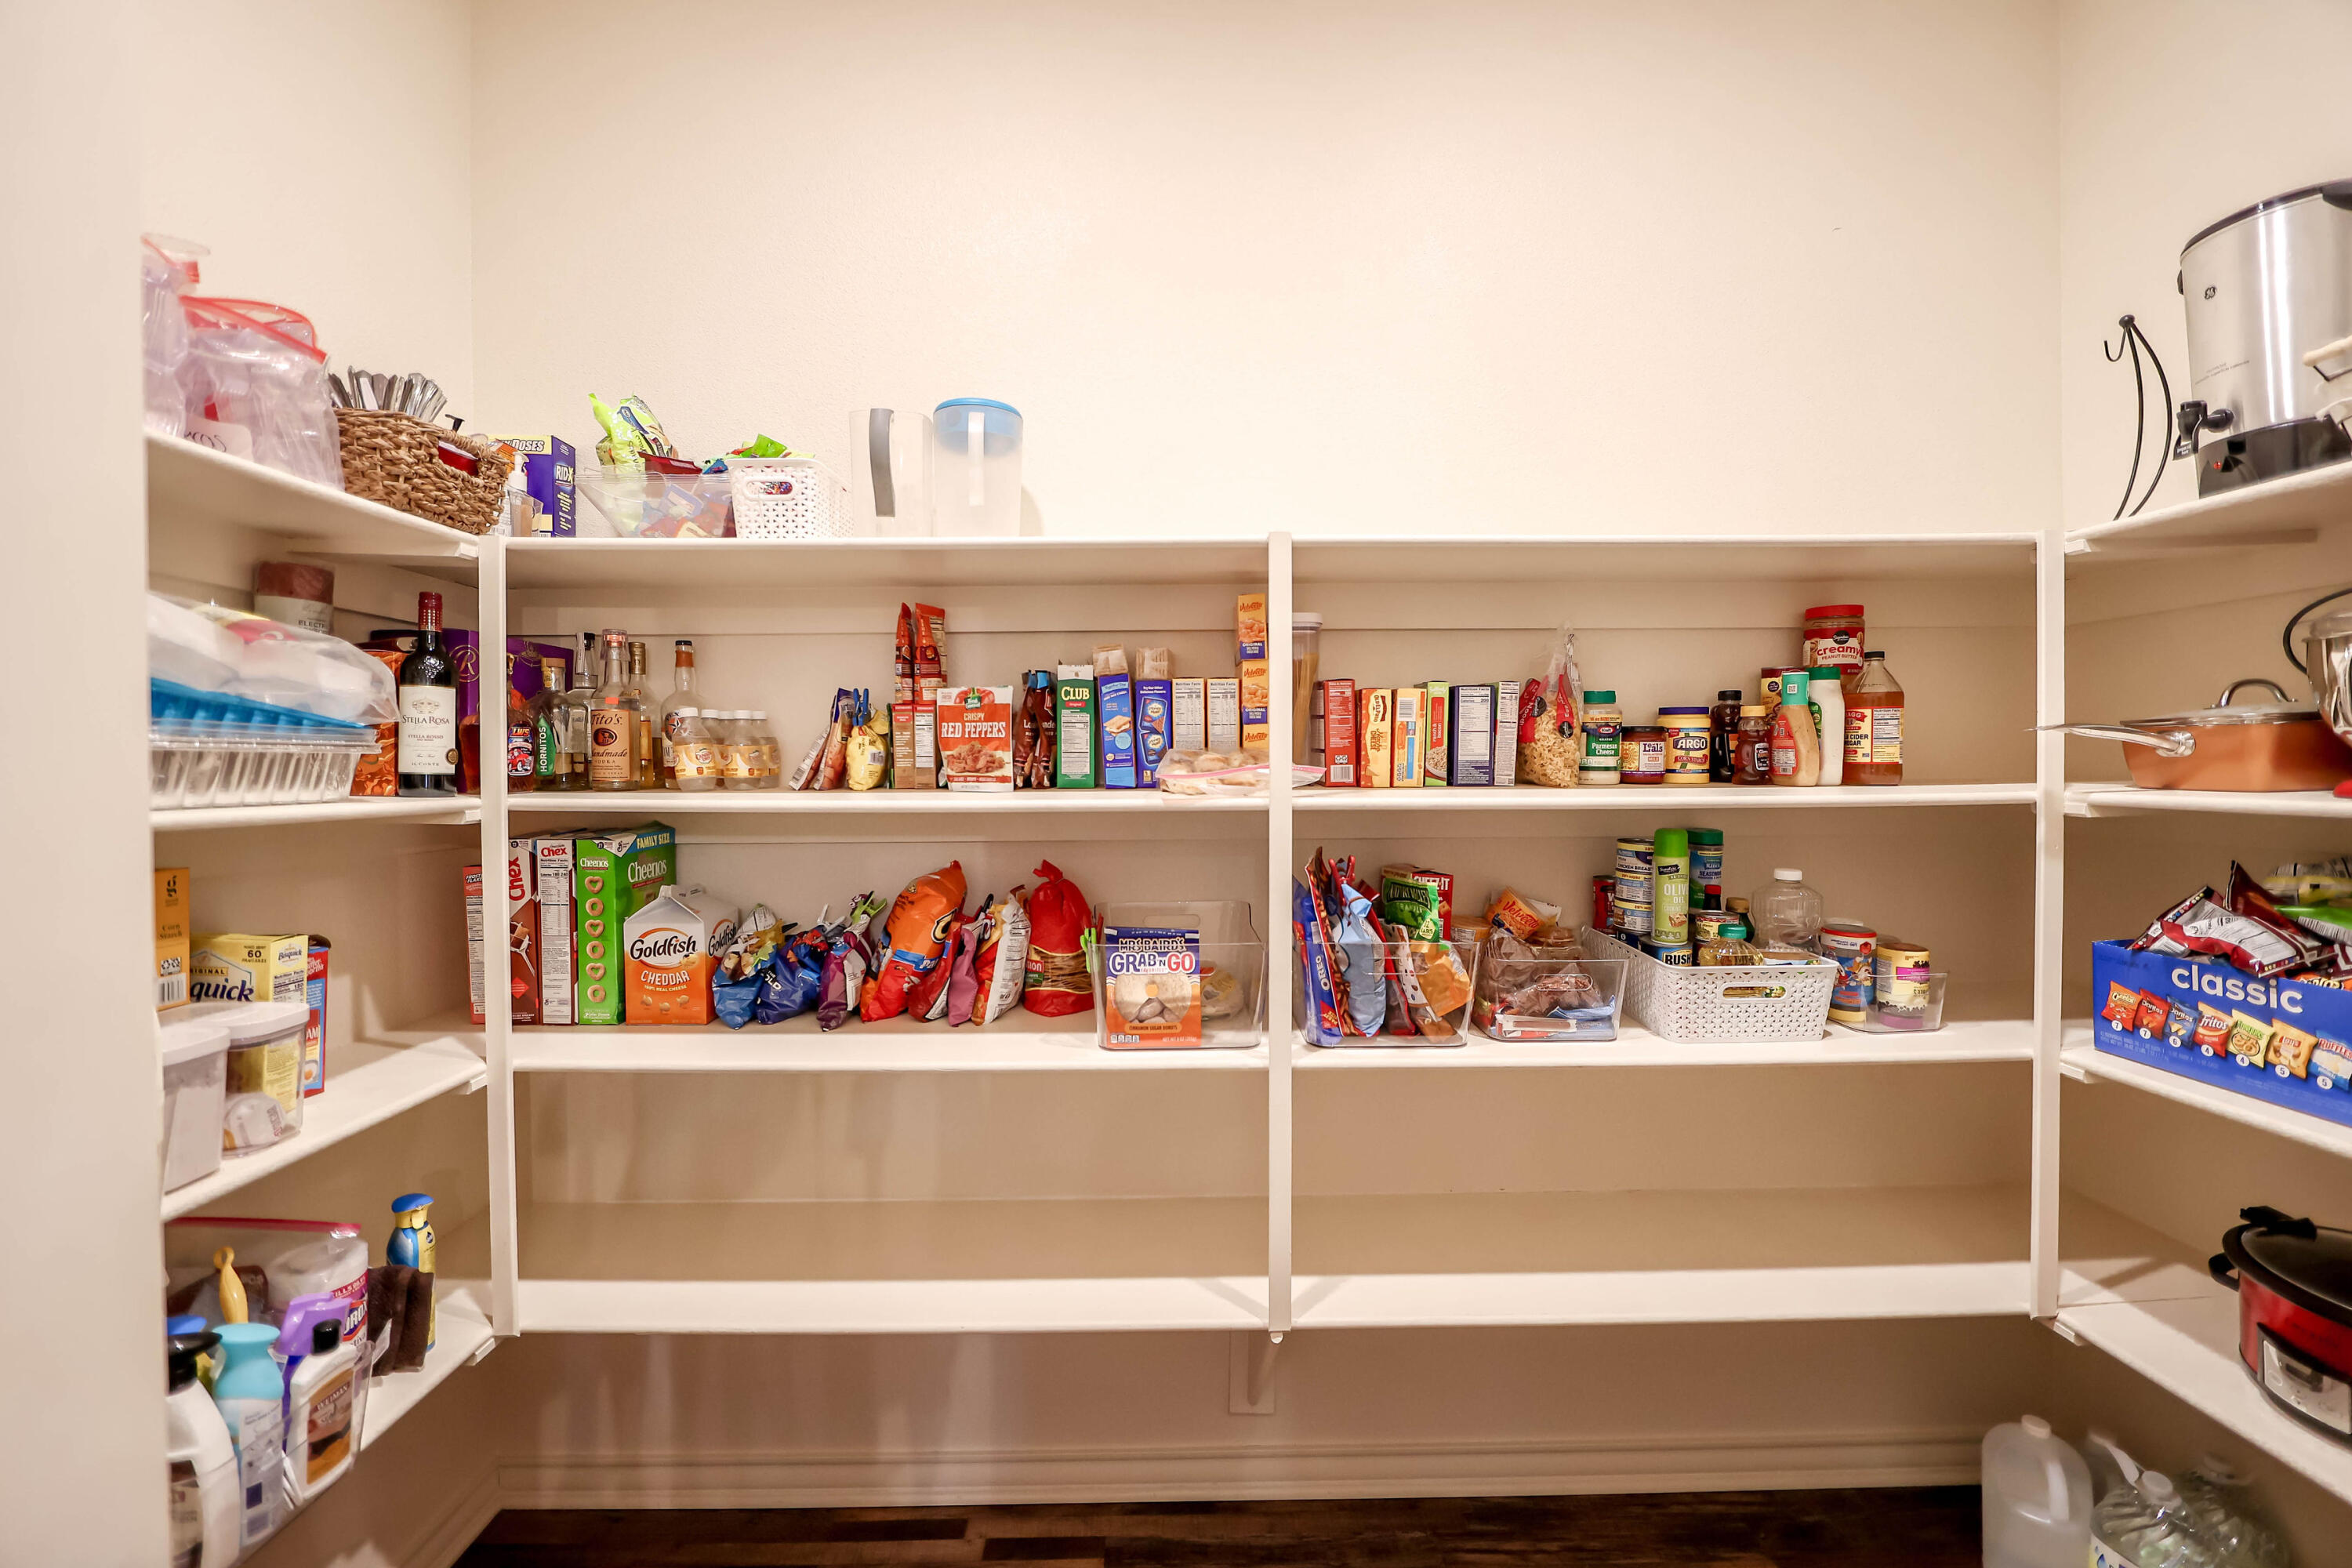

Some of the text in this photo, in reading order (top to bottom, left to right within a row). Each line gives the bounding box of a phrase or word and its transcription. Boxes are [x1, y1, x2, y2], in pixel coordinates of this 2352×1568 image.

[512, 439, 545, 452] DOSES
[1817, 646, 1861, 656] creamy
[1061, 686, 1090, 701] CLUB
[402, 715, 450, 726] STELLA ROSA
[941, 721, 963, 738] RED
[964, 721, 1006, 738] PEPPERS
[1244, 732, 1269, 742] Velveeta
[539, 727, 547, 772] HORNITOS
[1677, 739, 1706, 749] ARGO
[637, 833, 670, 849] FAMILY SIZE
[541, 847, 568, 857] Chex
[579, 858, 609, 868] Cheerios
[627, 860, 667, 883] Cheerios
[1502, 900, 1540, 929] Velveeta
[248, 949, 262, 958] 60
[278, 948, 303, 961] Bisquick
[630, 936, 697, 960] Goldfish
[1112, 953, 1156, 973] GRAB
[1168, 953, 1194, 972] GO
[641, 971, 690, 985] CHEDDAR
[1316, 955, 1330, 991] OREO
[190, 978, 254, 1002] quick
[2171, 964, 2303, 1014] classic
[2112, 992, 2136, 1004] Cheetos
[2141, 1000, 2163, 1014] Doritos
[2199, 1014, 2229, 1030] Fritos
[2319, 1038, 2352, 1059] RUFFLES
[343, 1301, 367, 1334] ROX
